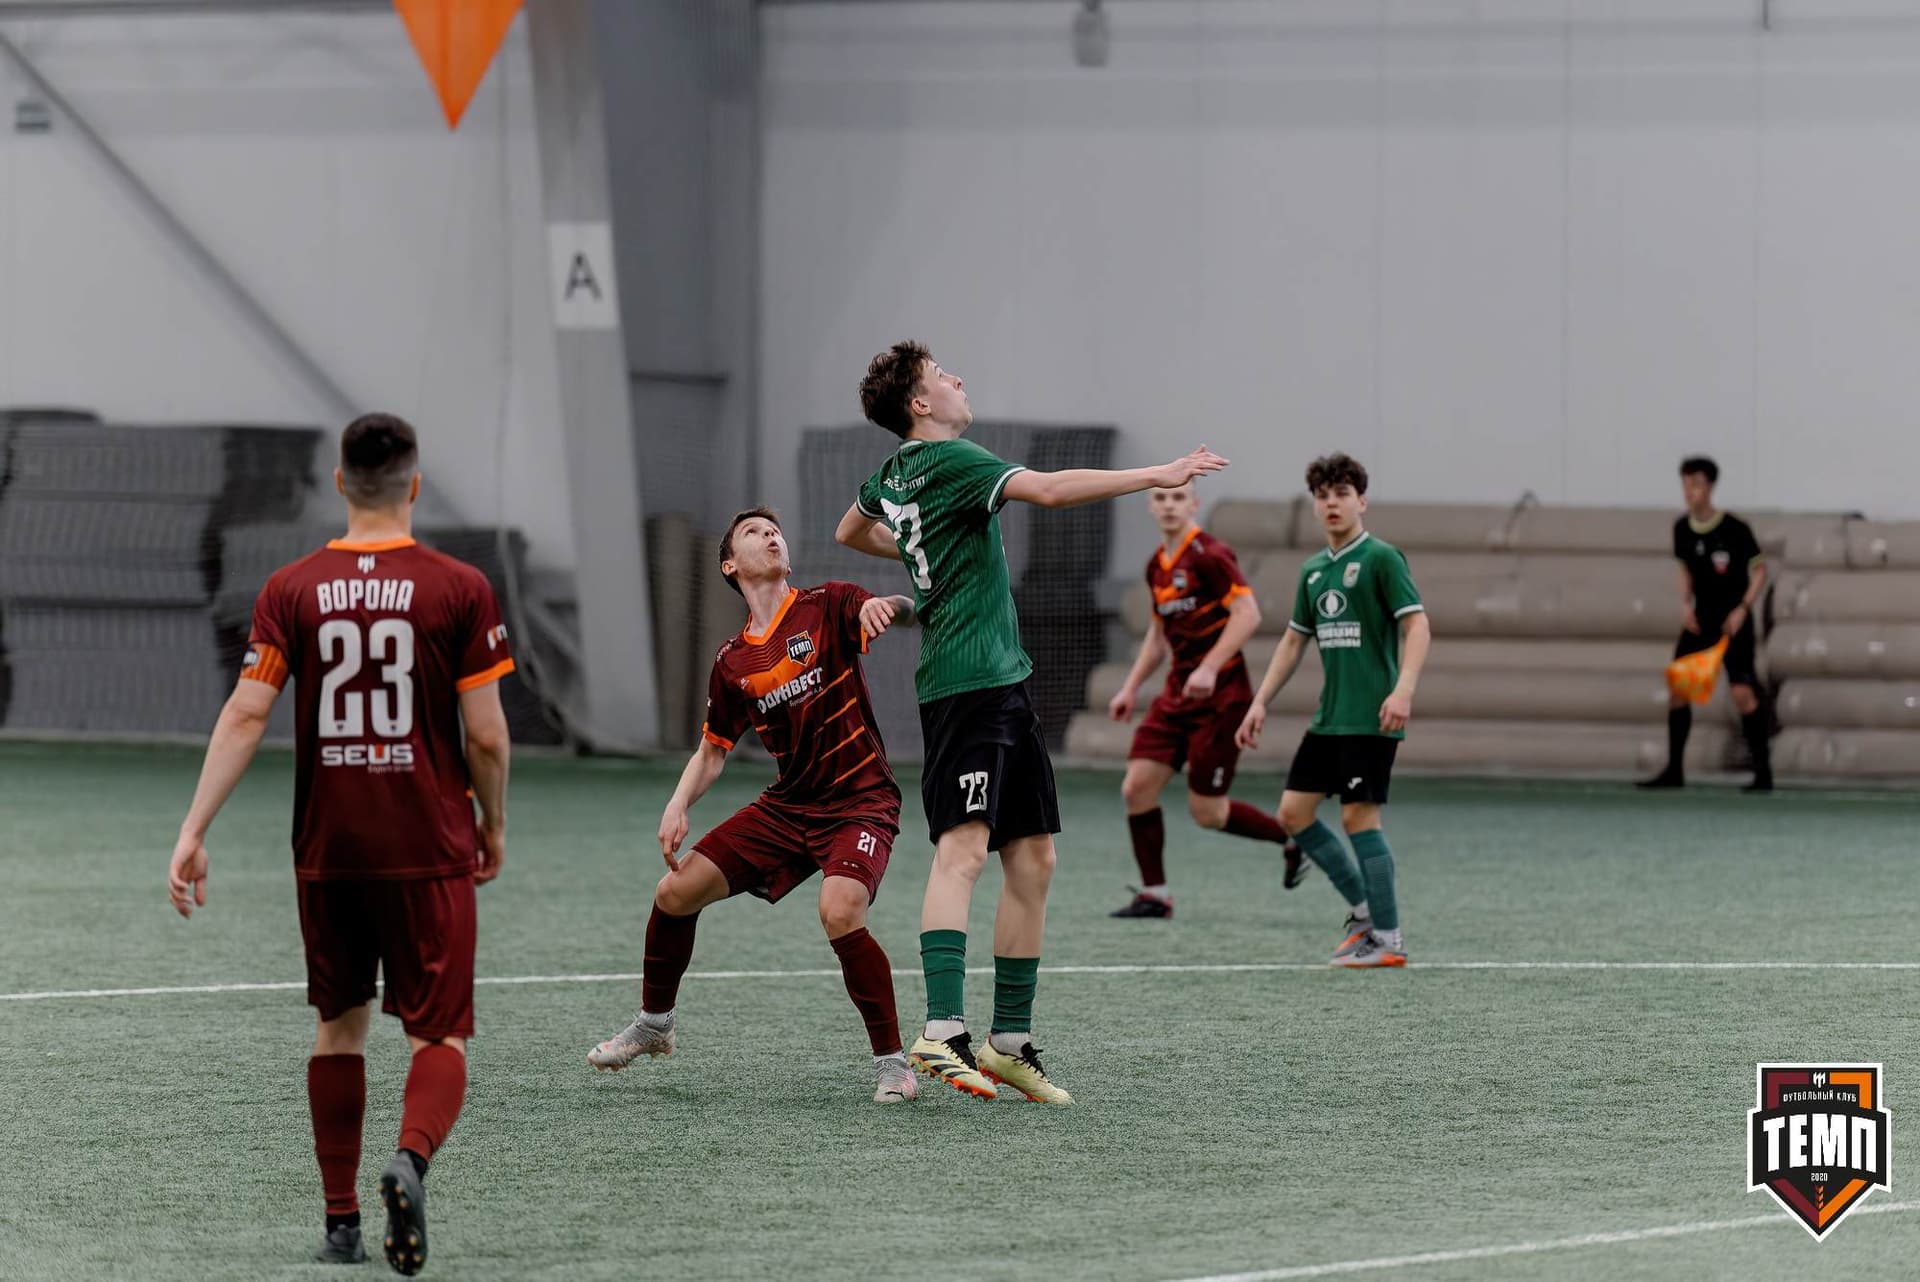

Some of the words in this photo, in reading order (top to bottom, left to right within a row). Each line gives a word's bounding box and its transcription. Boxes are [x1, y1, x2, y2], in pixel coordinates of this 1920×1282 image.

[316, 578, 415, 615] ВОРОНА
[789, 640, 812, 658] ТЕМП
[318, 618, 415, 738] 23
[321, 743, 414, 767] SEUS
[959, 771, 989, 814] 23
[856, 831, 877, 857] 21
